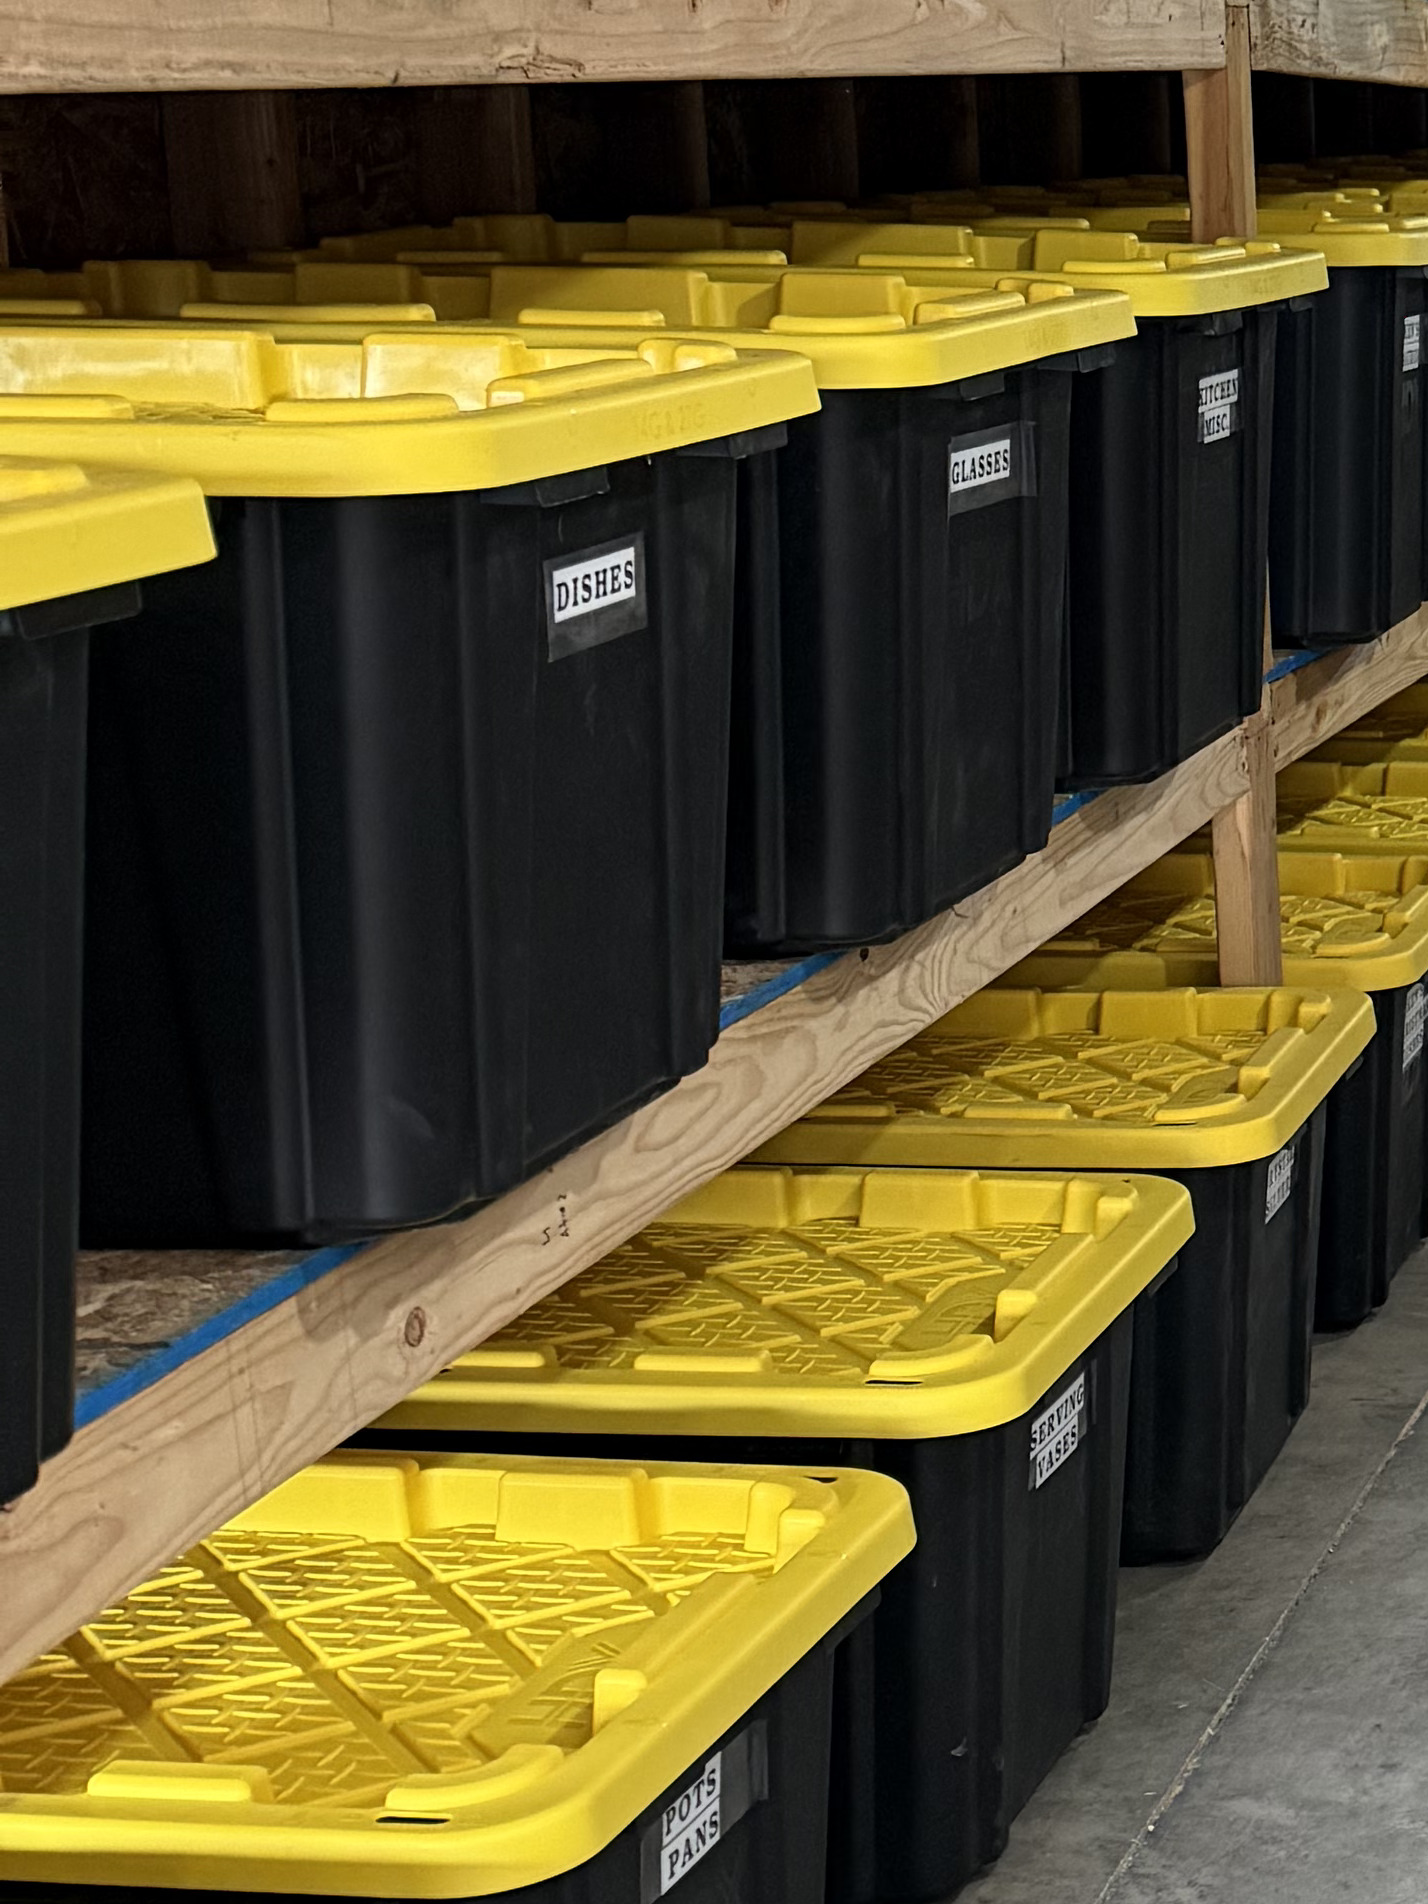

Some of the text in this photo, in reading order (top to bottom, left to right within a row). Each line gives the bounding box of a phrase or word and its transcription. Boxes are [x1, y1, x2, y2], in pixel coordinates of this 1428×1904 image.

[951, 448, 1009, 486] GLASSES
[556, 559, 635, 614] DISHES
[1030, 1383, 1085, 1451] SERVING
[1036, 1422, 1078, 1480] VASES
[663, 1767, 719, 1838] POTS
[666, 1809, 720, 1881] PANS
